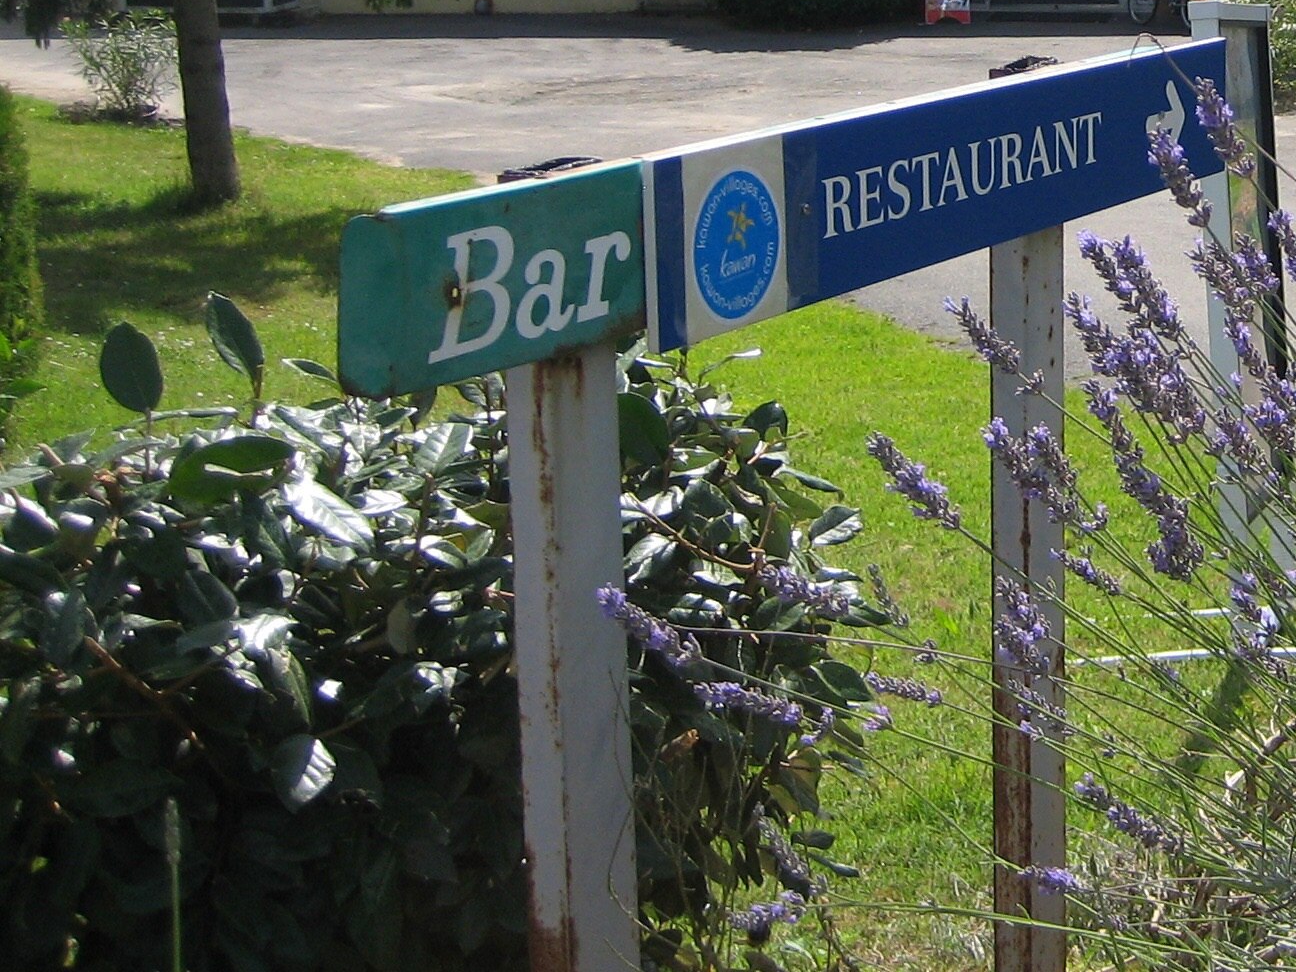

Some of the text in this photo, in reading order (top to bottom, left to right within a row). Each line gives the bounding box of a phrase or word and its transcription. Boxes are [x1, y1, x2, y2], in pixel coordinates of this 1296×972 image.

[821, 111, 1102, 240] RESTAURANT
[428, 226, 631, 365] Bar
[721, 249, 756, 277] kawan
